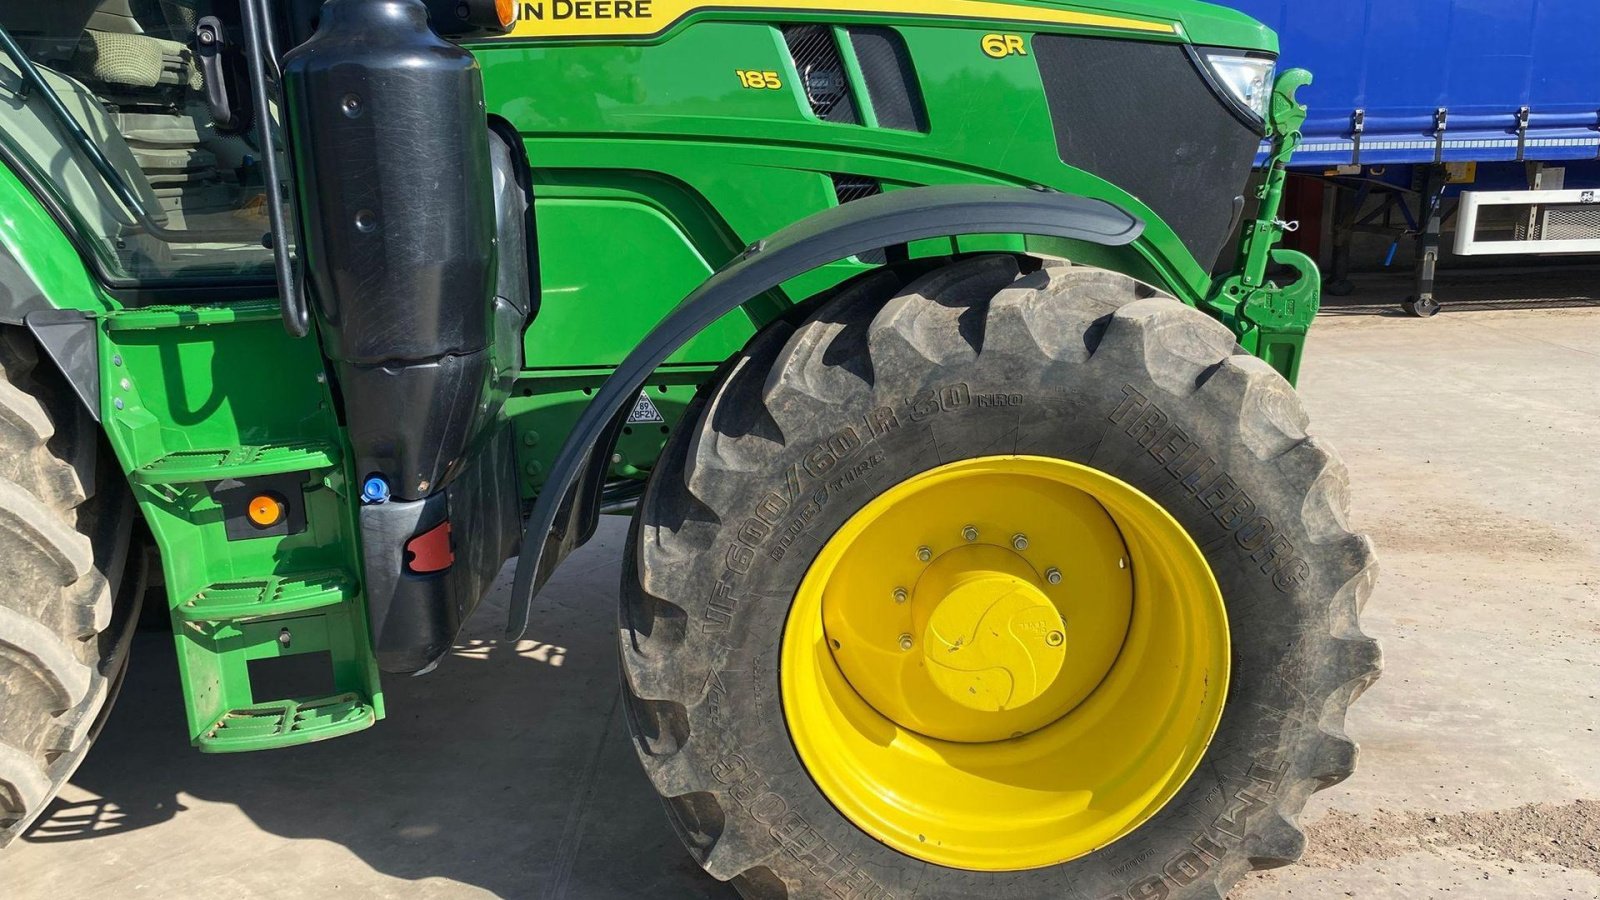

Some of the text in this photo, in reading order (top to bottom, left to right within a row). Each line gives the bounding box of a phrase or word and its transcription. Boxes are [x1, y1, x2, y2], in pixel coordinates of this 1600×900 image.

[552, 0, 653, 20] DEERE
[980, 33, 1027, 59] 6R
[736, 69, 782, 90] 185
[639, 402, 649, 410] 89
[1107, 384, 1311, 594] TRELLEBORG
[702, 580, 738, 635] VF
[726, 426, 862, 576] 600/60
[978, 393, 1024, 408] NRO
[770, 502, 817, 563] BLUE
[1098, 760, 1292, 900] TM106
